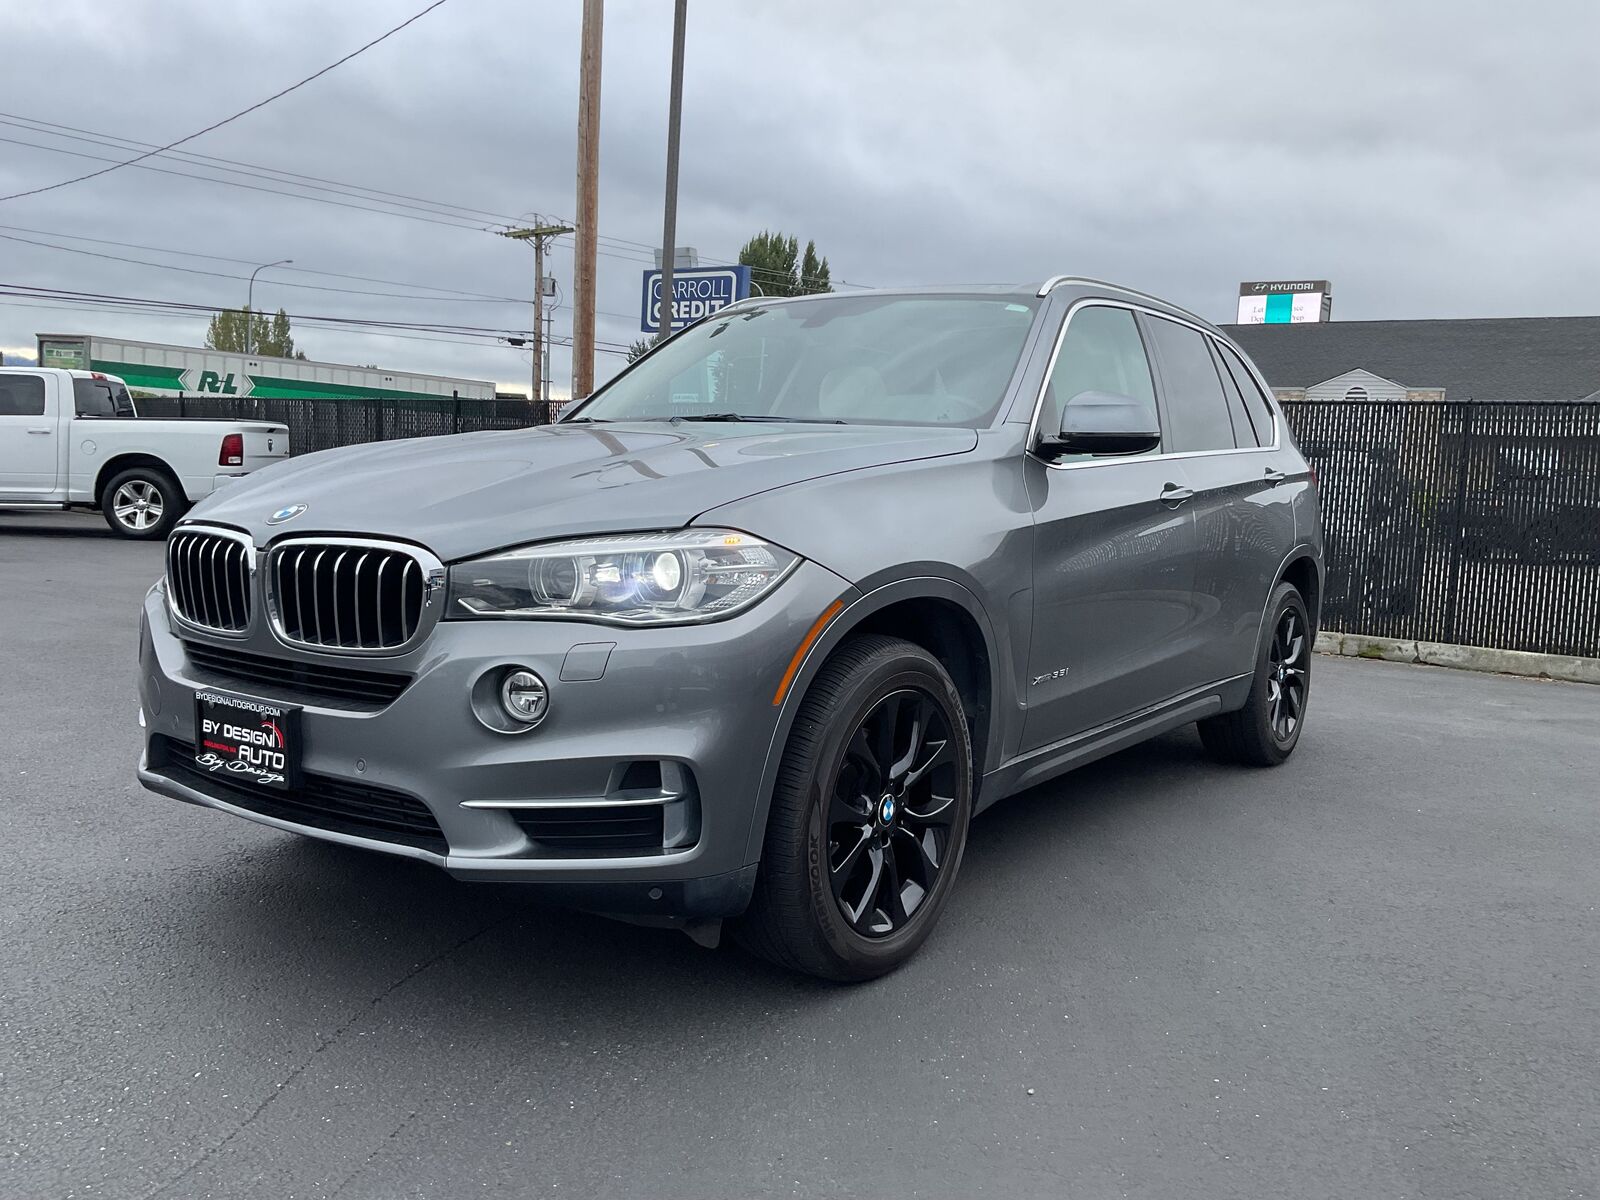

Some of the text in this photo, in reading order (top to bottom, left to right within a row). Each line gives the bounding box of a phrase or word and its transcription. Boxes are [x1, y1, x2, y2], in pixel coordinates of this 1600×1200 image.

[1270, 283, 1314, 291] HYUNDAI
[195, 691, 280, 717] BYDESIGNAUTOGROUP.COM
[203, 719, 220, 735] BY
[224, 724, 273, 747] DESIGN
[239, 745, 285, 769] AUTO
